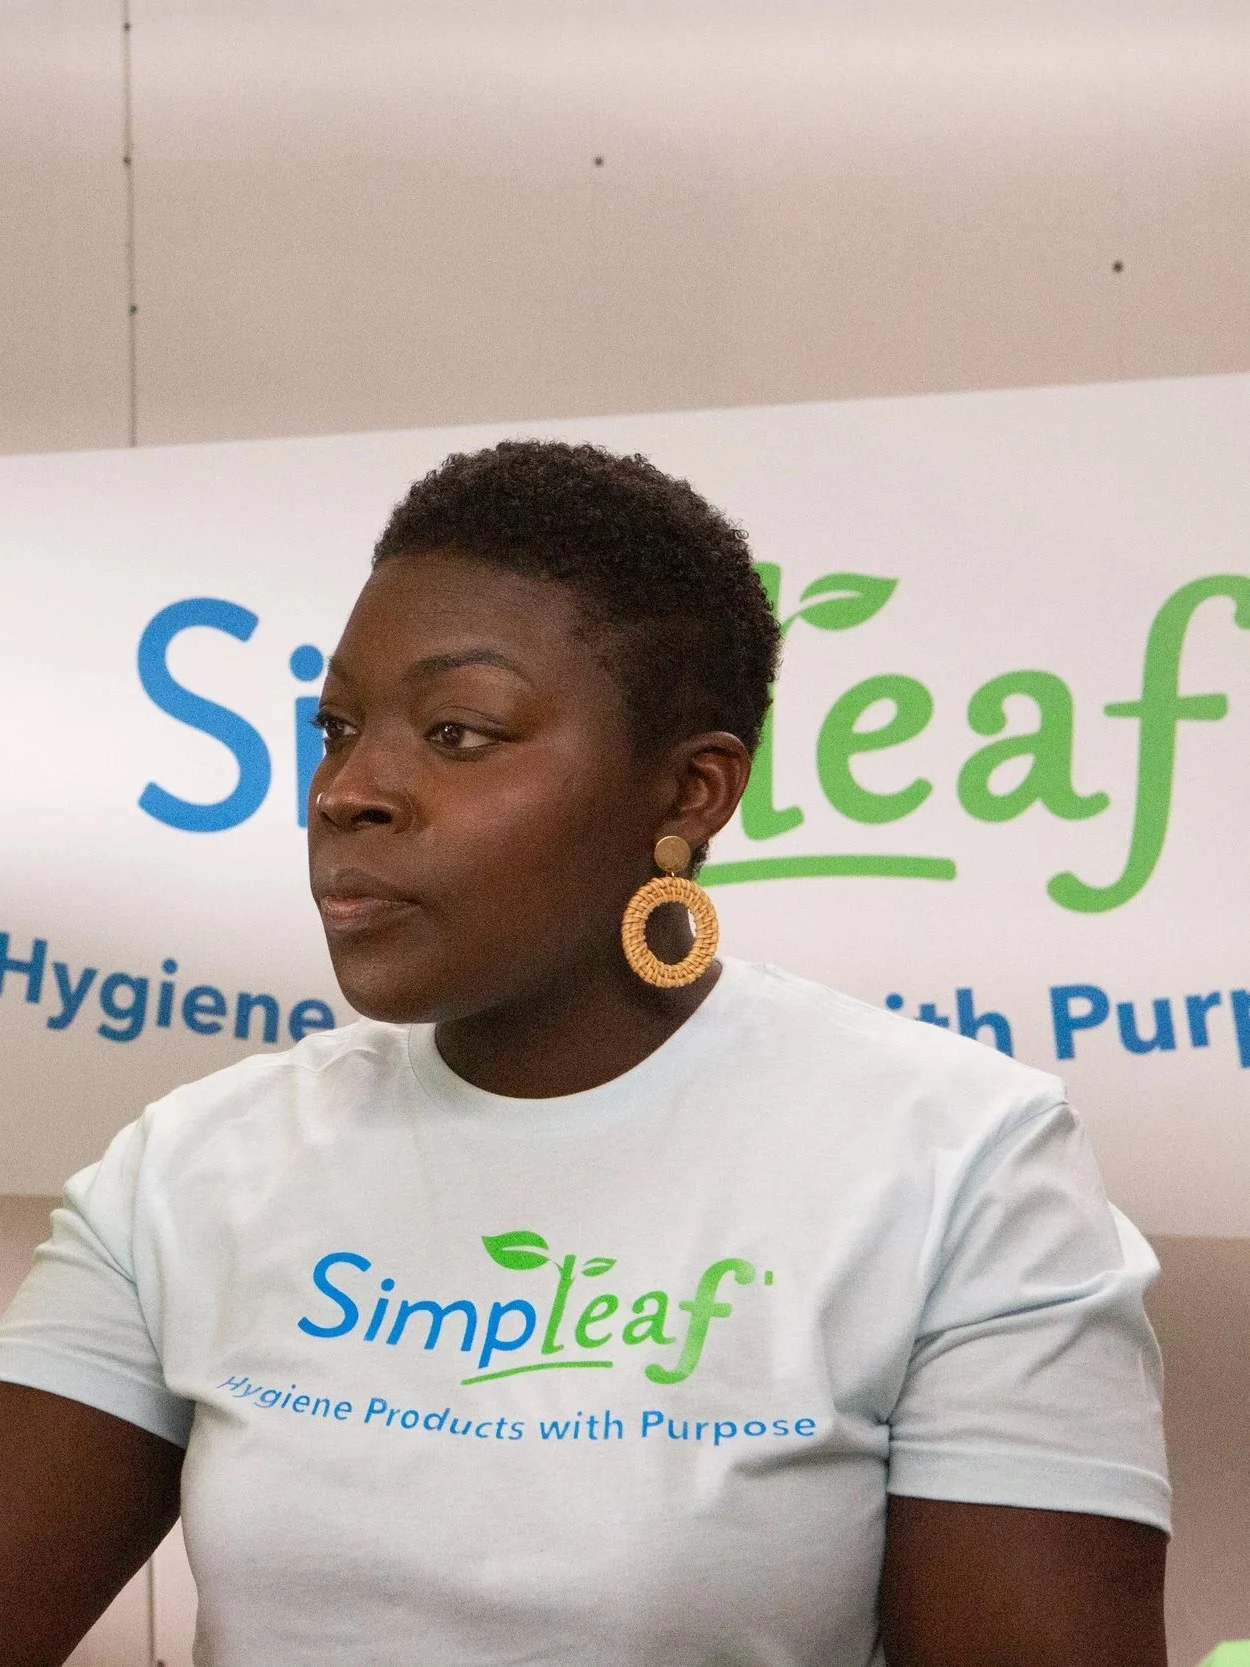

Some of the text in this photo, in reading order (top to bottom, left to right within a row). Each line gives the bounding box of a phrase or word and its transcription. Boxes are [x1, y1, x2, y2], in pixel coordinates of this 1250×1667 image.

[297, 1251, 756, 1385] Simpleaf
[216, 1375, 817, 1447] Hygiene Products with Purpose
